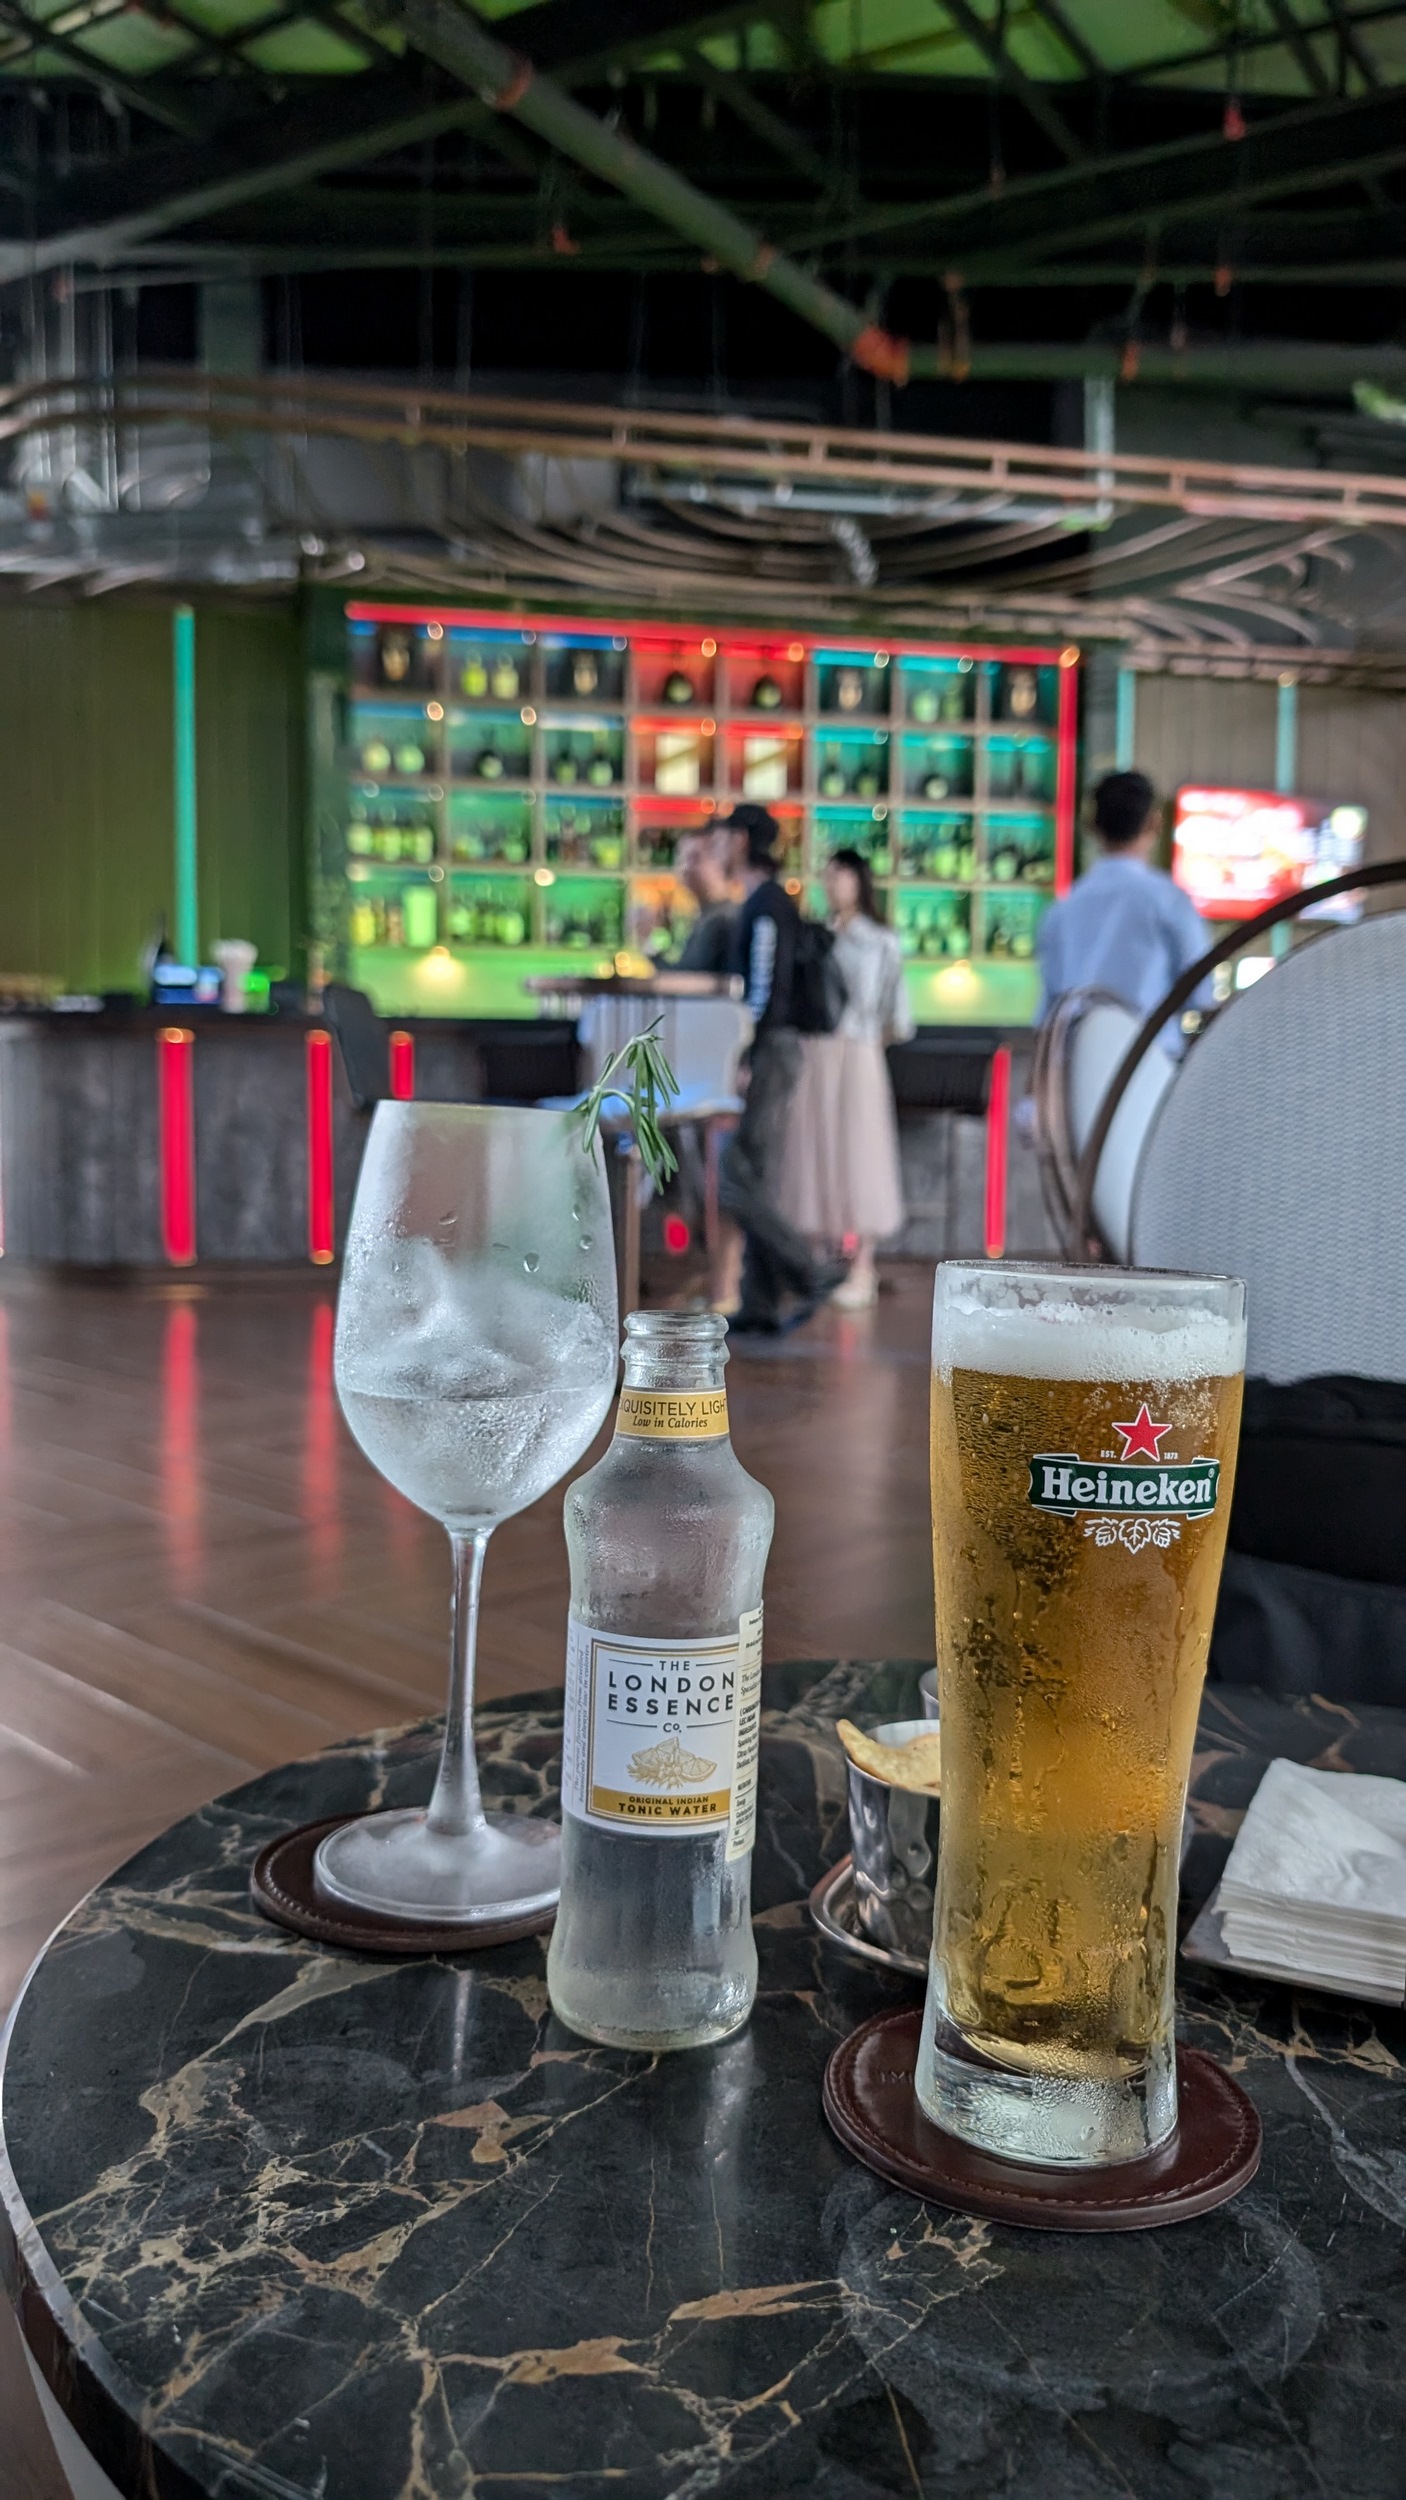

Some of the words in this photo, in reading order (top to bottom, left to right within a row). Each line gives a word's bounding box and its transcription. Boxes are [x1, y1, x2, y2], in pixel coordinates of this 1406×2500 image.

[632, 1415, 651, 1427] Low
[654, 1416, 664, 1428] in
[668, 1417, 708, 1428] Calories
[1100, 1450, 1117, 1459] EST.
[1163, 1452, 1178, 1460] 1873
[659, 1660, 690, 1671] THE
[608, 1671, 735, 1694] LONDON
[608, 1693, 734, 1716] ESSENCE
[628, 1796, 673, 1806] ORIGINAL
[677, 1796, 709, 1806] INDIAN
[618, 1802, 662, 1815] TONIC
[670, 1803, 717, 1816] WATER
